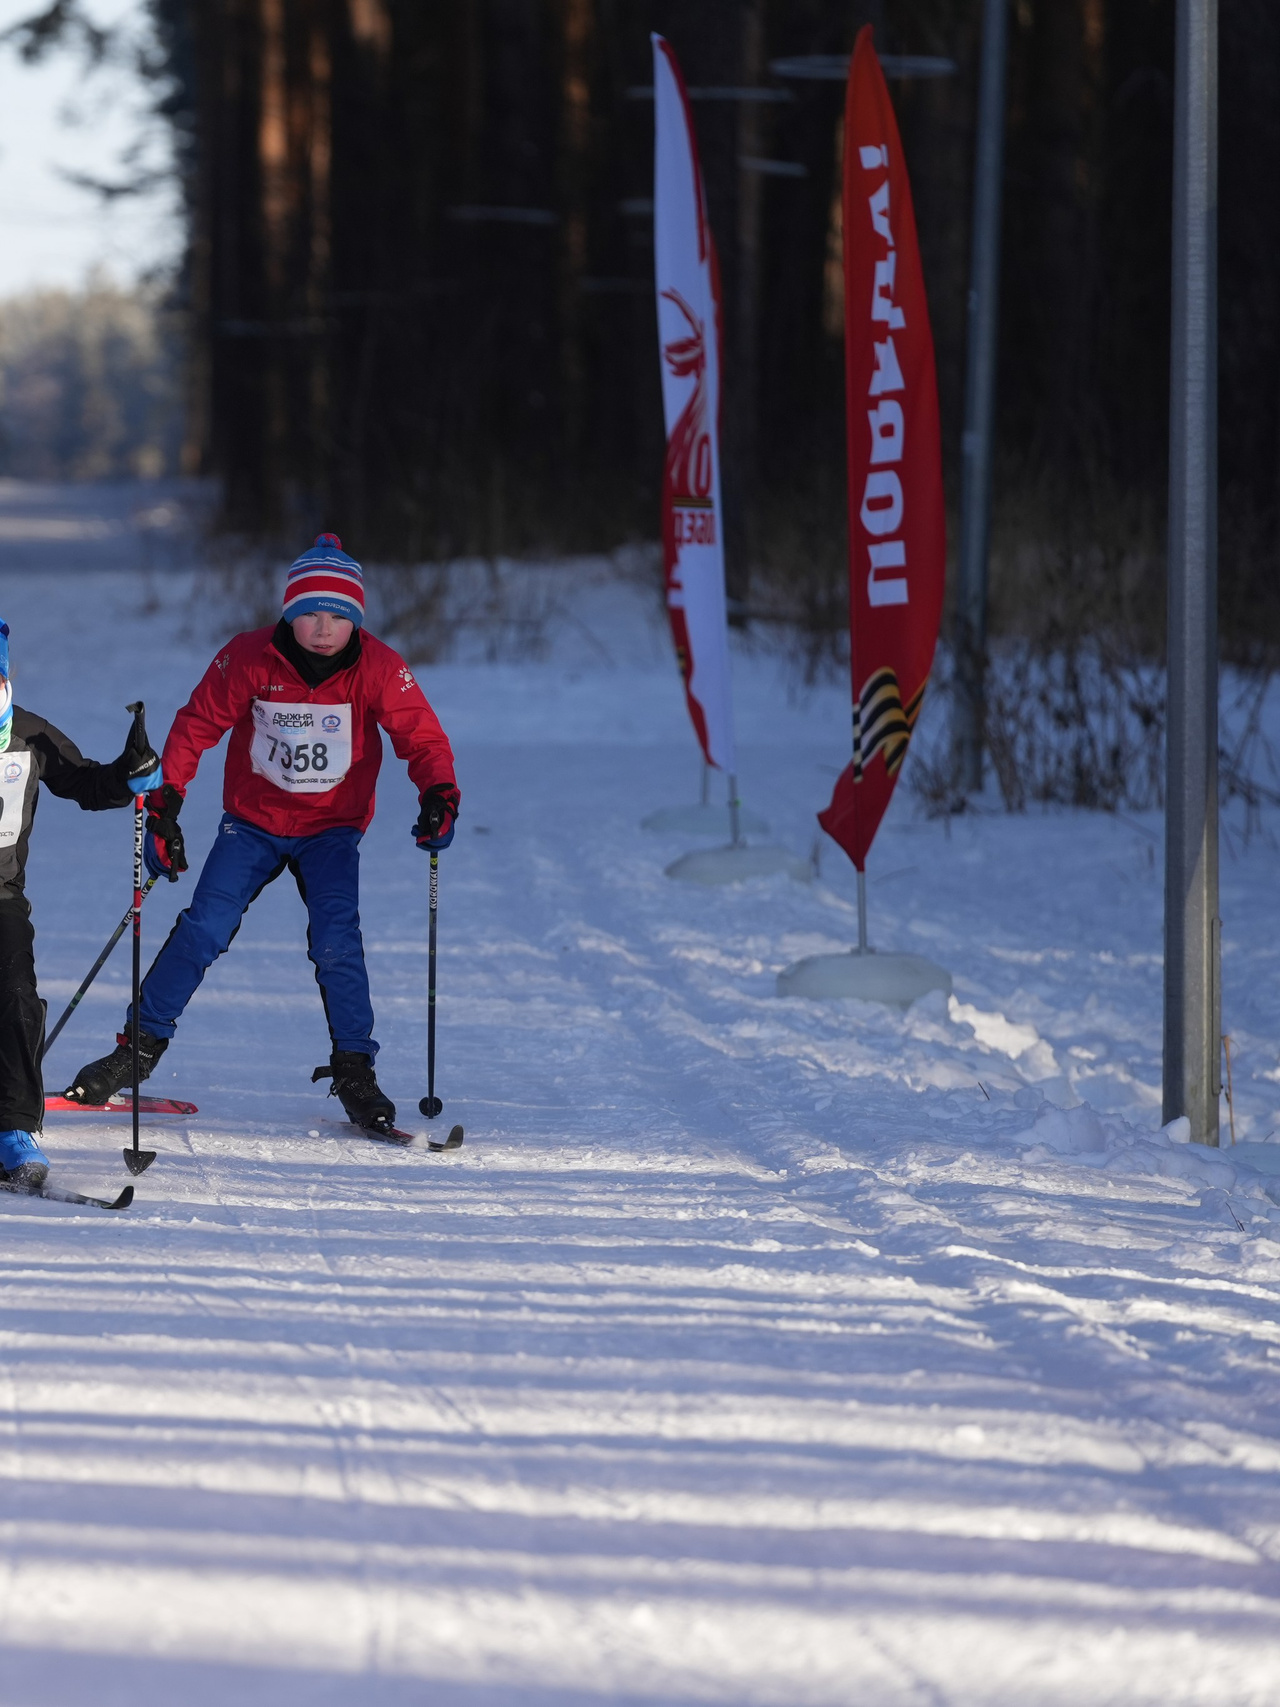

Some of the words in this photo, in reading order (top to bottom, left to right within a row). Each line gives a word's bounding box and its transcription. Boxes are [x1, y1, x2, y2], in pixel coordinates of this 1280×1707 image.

[273, 712, 313, 720] ЛЫЖНЯ
[272, 719, 314, 728] РОССИИ
[266, 733, 328, 773] 7358
